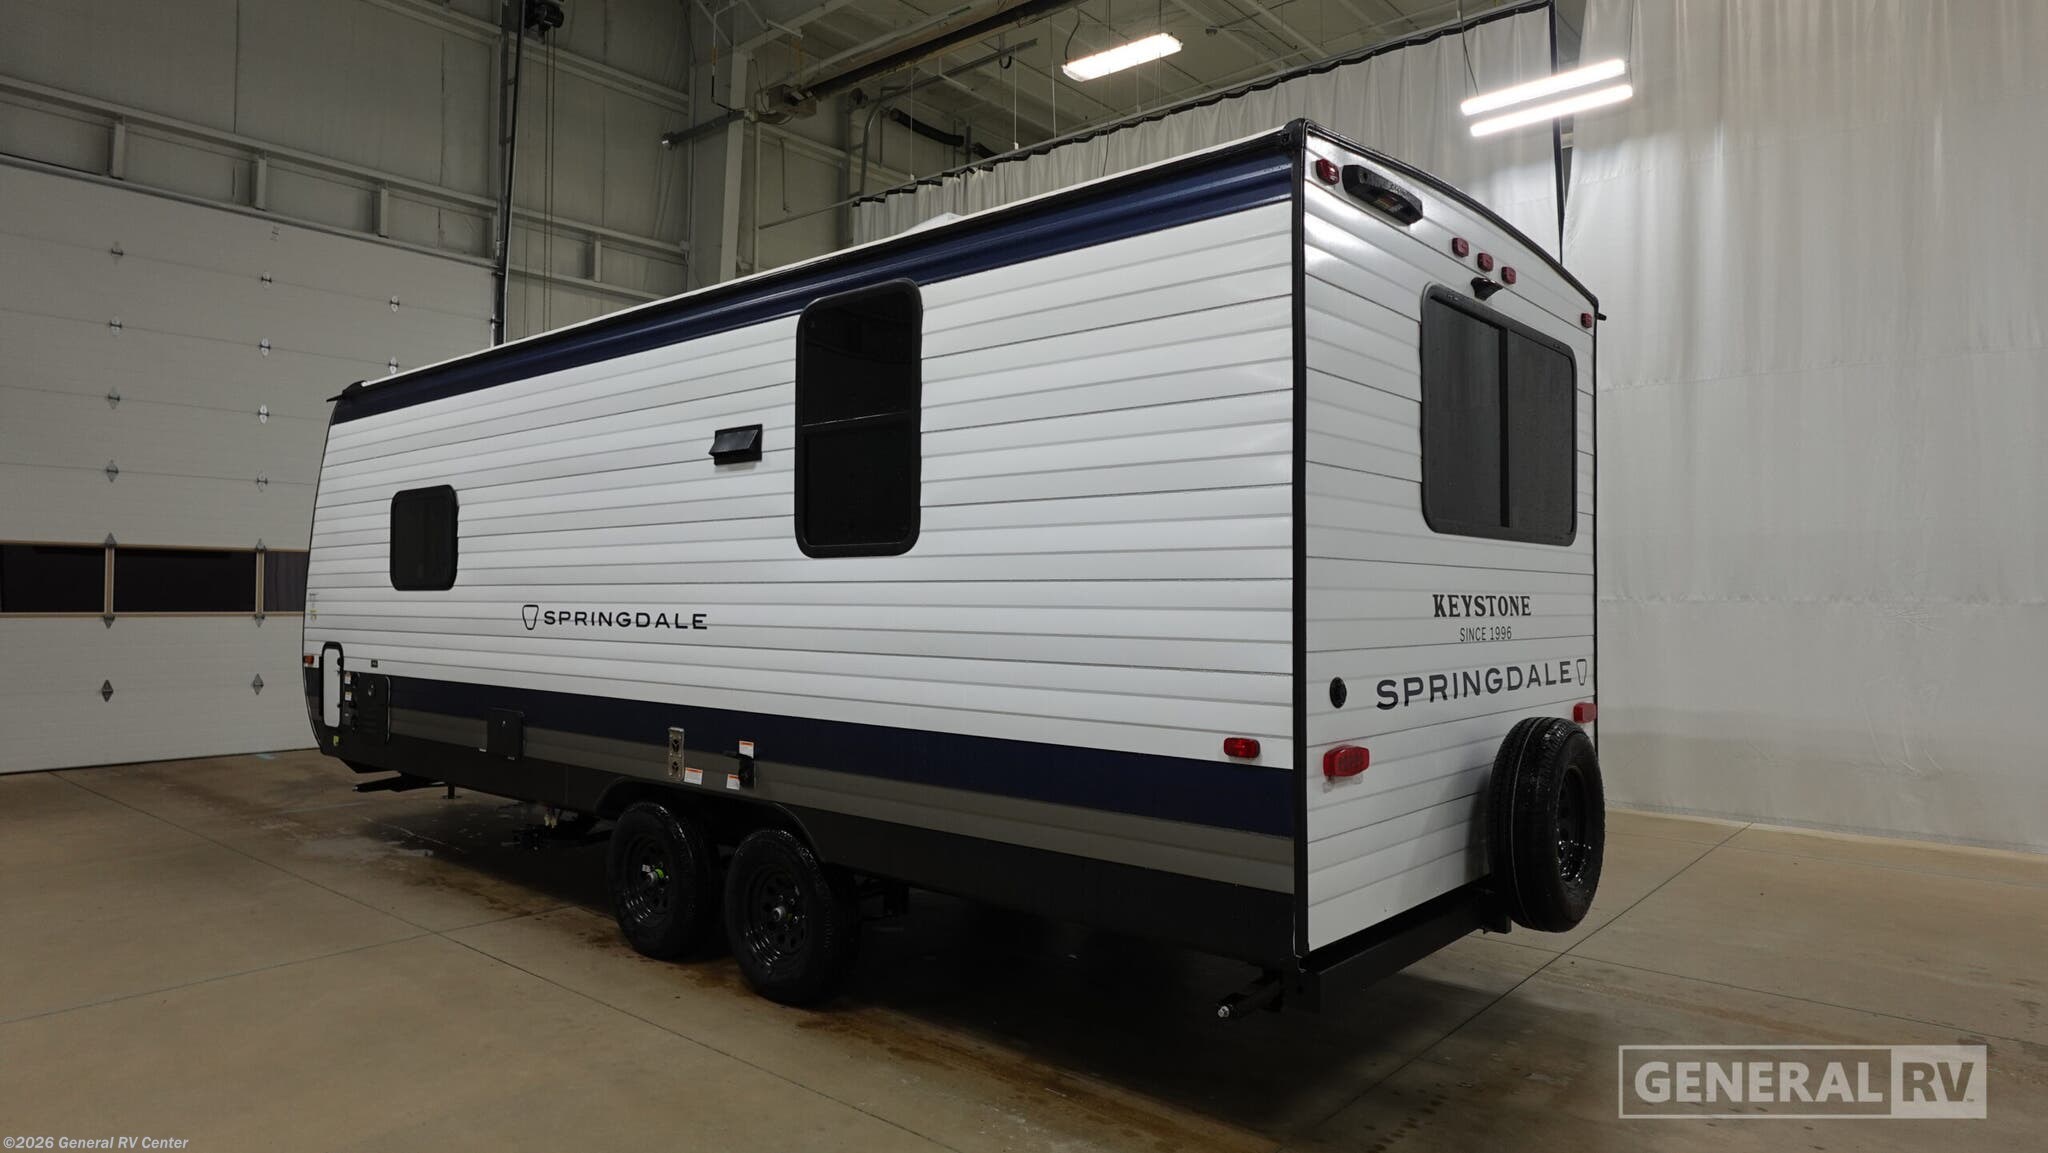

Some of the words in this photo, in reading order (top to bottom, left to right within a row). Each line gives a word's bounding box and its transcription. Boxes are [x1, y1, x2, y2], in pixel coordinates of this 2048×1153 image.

[1433, 594, 1532, 617] KEYSTONE
[543, 610, 708, 630] SPRINGDALE
[1459, 627, 1487, 642] SINCE
[1489, 626, 1512, 641] 1996
[1376, 661, 1572, 710] SPRINGDALE
